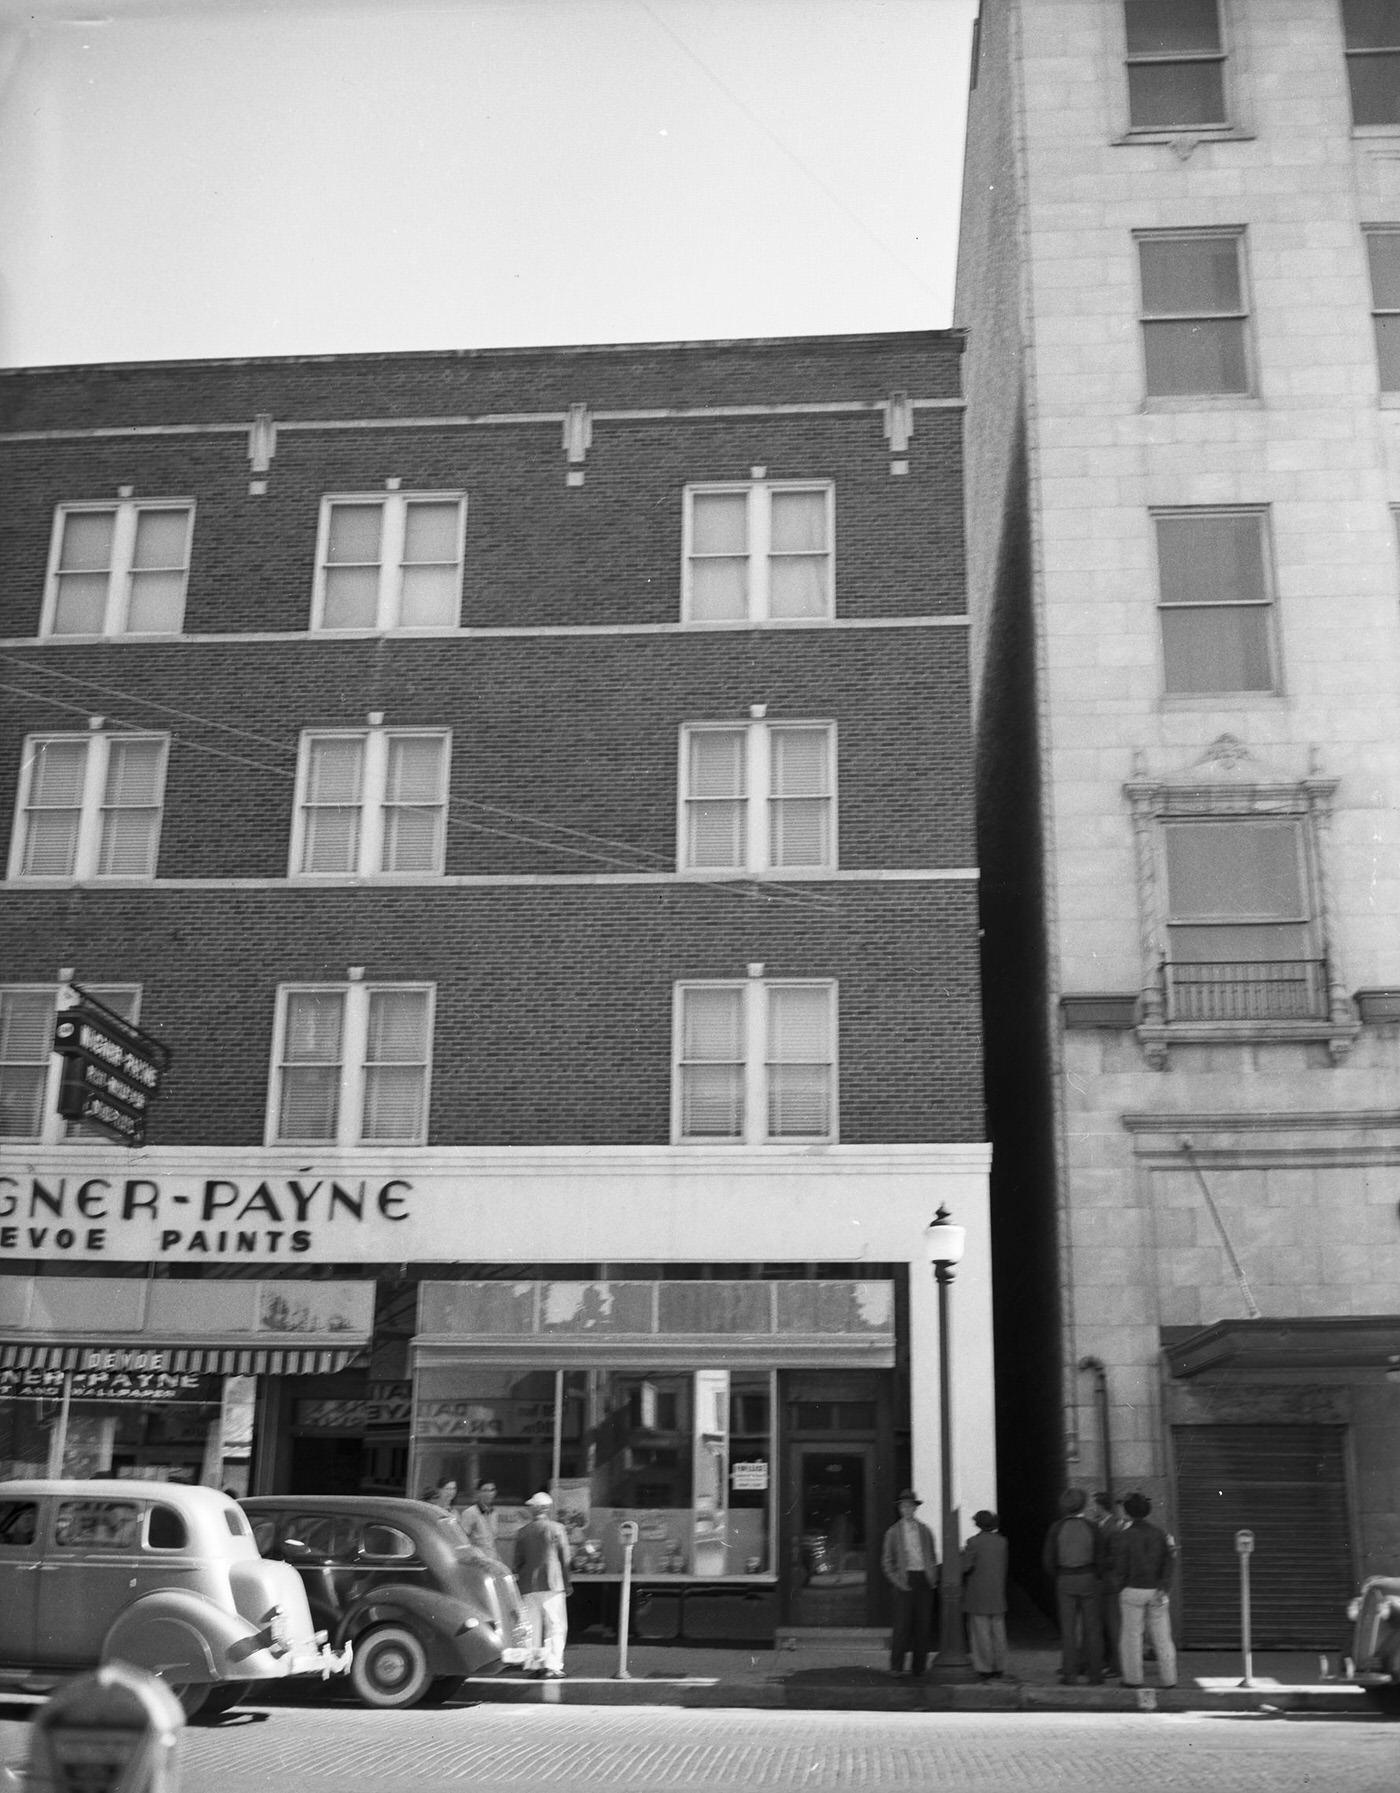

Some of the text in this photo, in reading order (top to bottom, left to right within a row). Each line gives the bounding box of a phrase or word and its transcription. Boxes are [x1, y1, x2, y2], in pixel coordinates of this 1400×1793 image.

[0, 1226, 312, 1252] EVOE PAINTS
[87, 1352, 163, 1369] DEVOE
